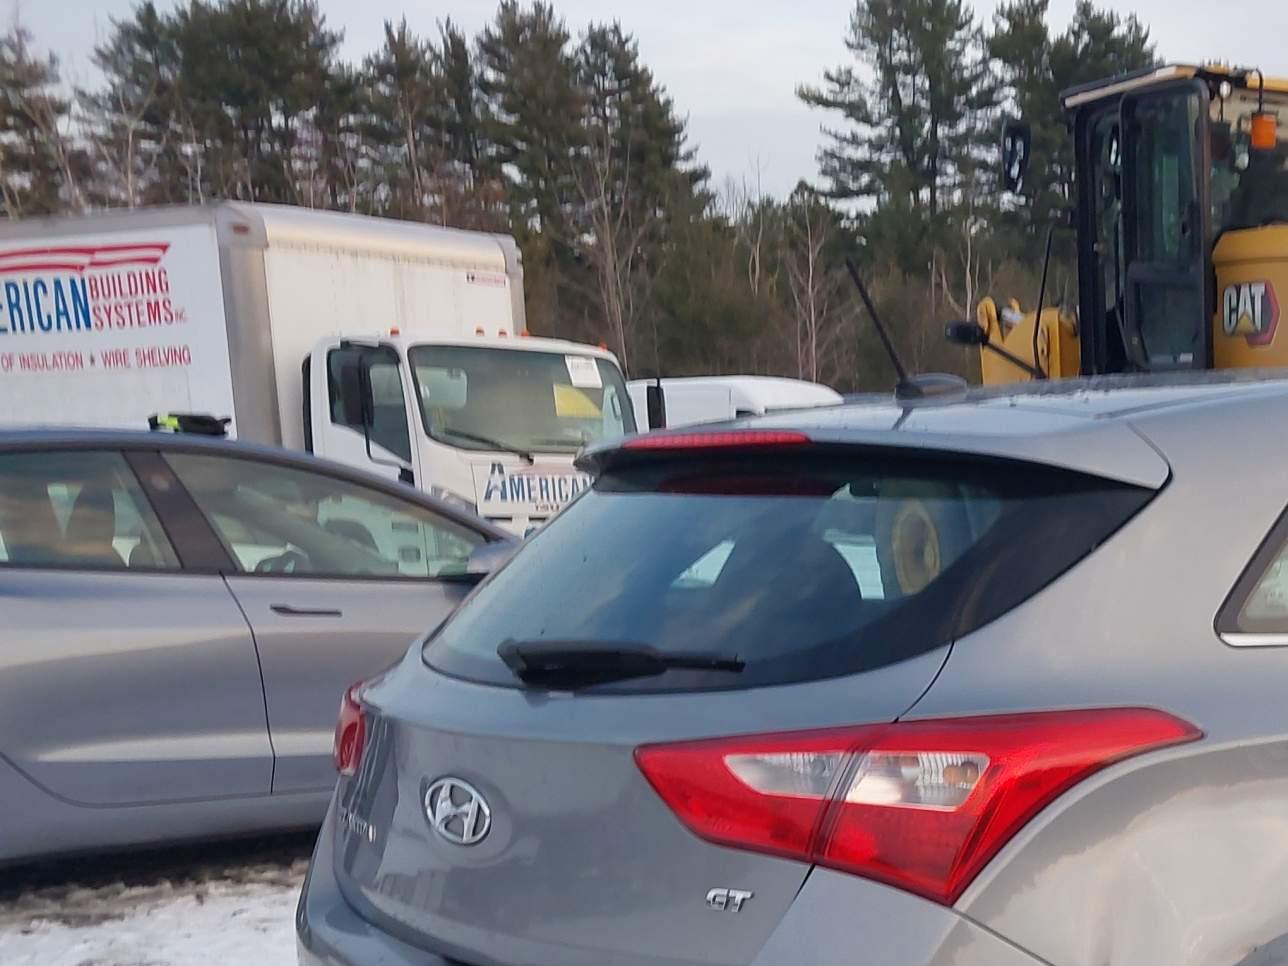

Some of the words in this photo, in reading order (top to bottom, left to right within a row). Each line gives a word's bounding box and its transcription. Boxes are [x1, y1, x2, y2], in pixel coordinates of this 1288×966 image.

[89, 268, 169, 300] BUILDING
[92, 299, 174, 332] SYSTEMS
[1223, 282, 1266, 336] CAT
[1, 352, 14, 370] OF
[18, 350, 84, 370] INSULATION
[101, 347, 131, 369] WIRE
[135, 344, 192, 368] SHELVING
[705, 887, 753, 913] GT
